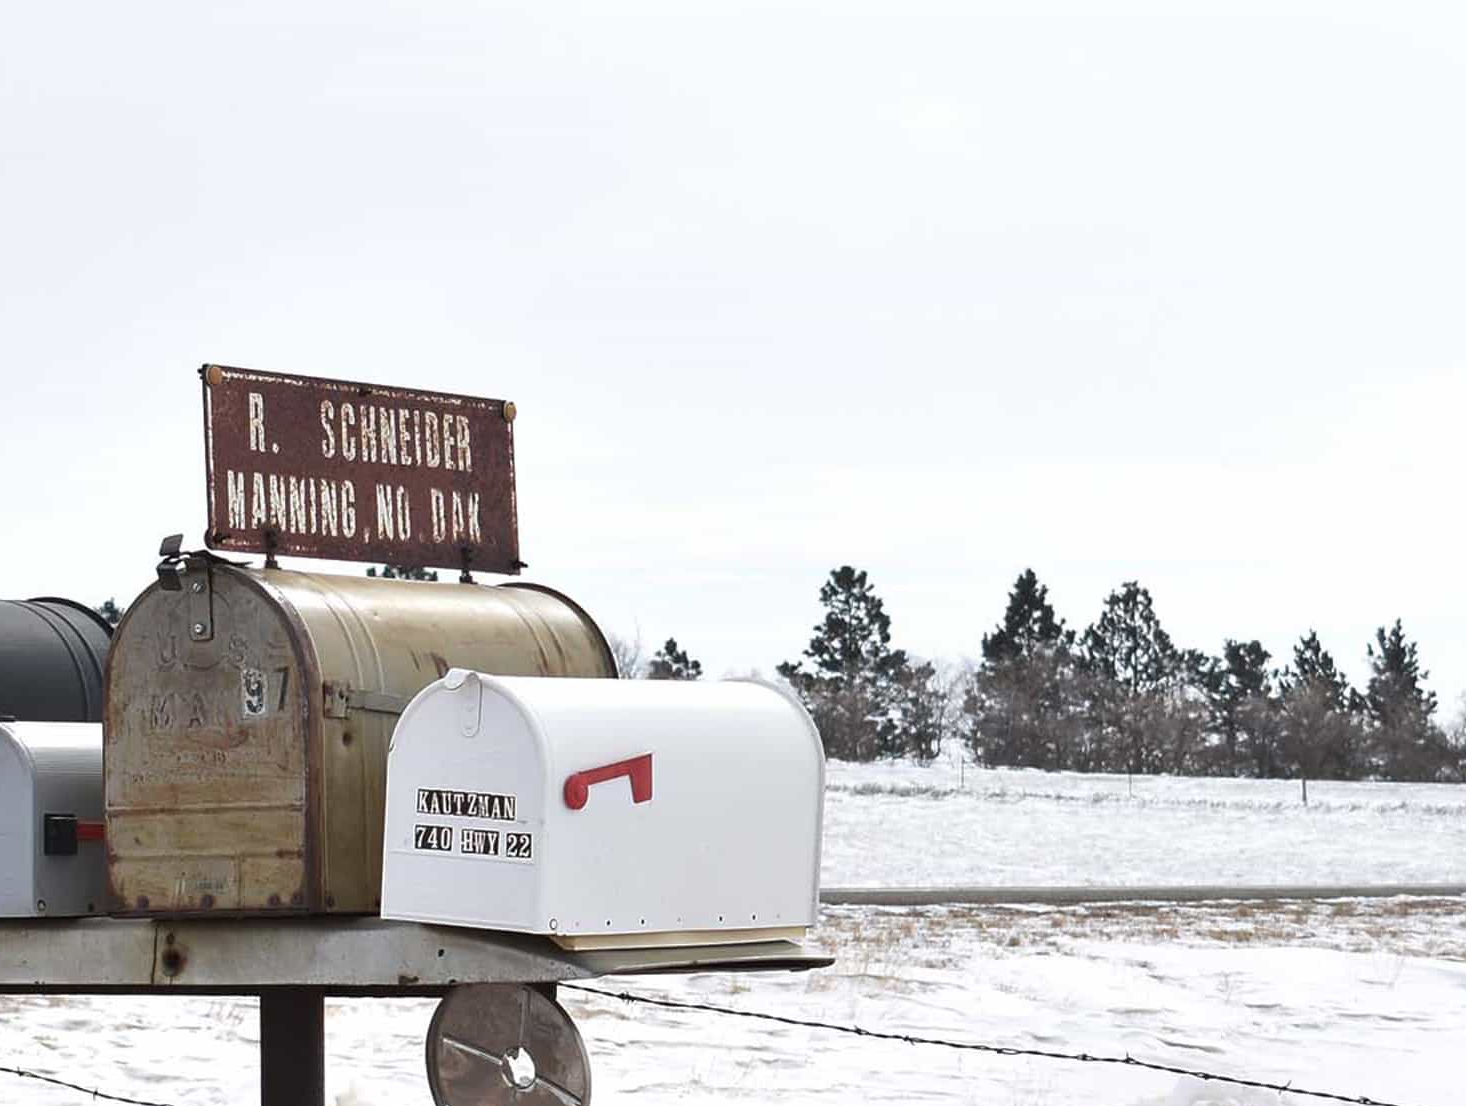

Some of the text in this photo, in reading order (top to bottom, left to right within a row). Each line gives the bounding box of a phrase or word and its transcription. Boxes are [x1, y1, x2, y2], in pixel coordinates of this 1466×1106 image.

[249, 392, 472, 472] R. SCHNEIDER
[418, 791, 515, 819] KAUTZMAN
[416, 826, 530, 857] 740 HWY 22
